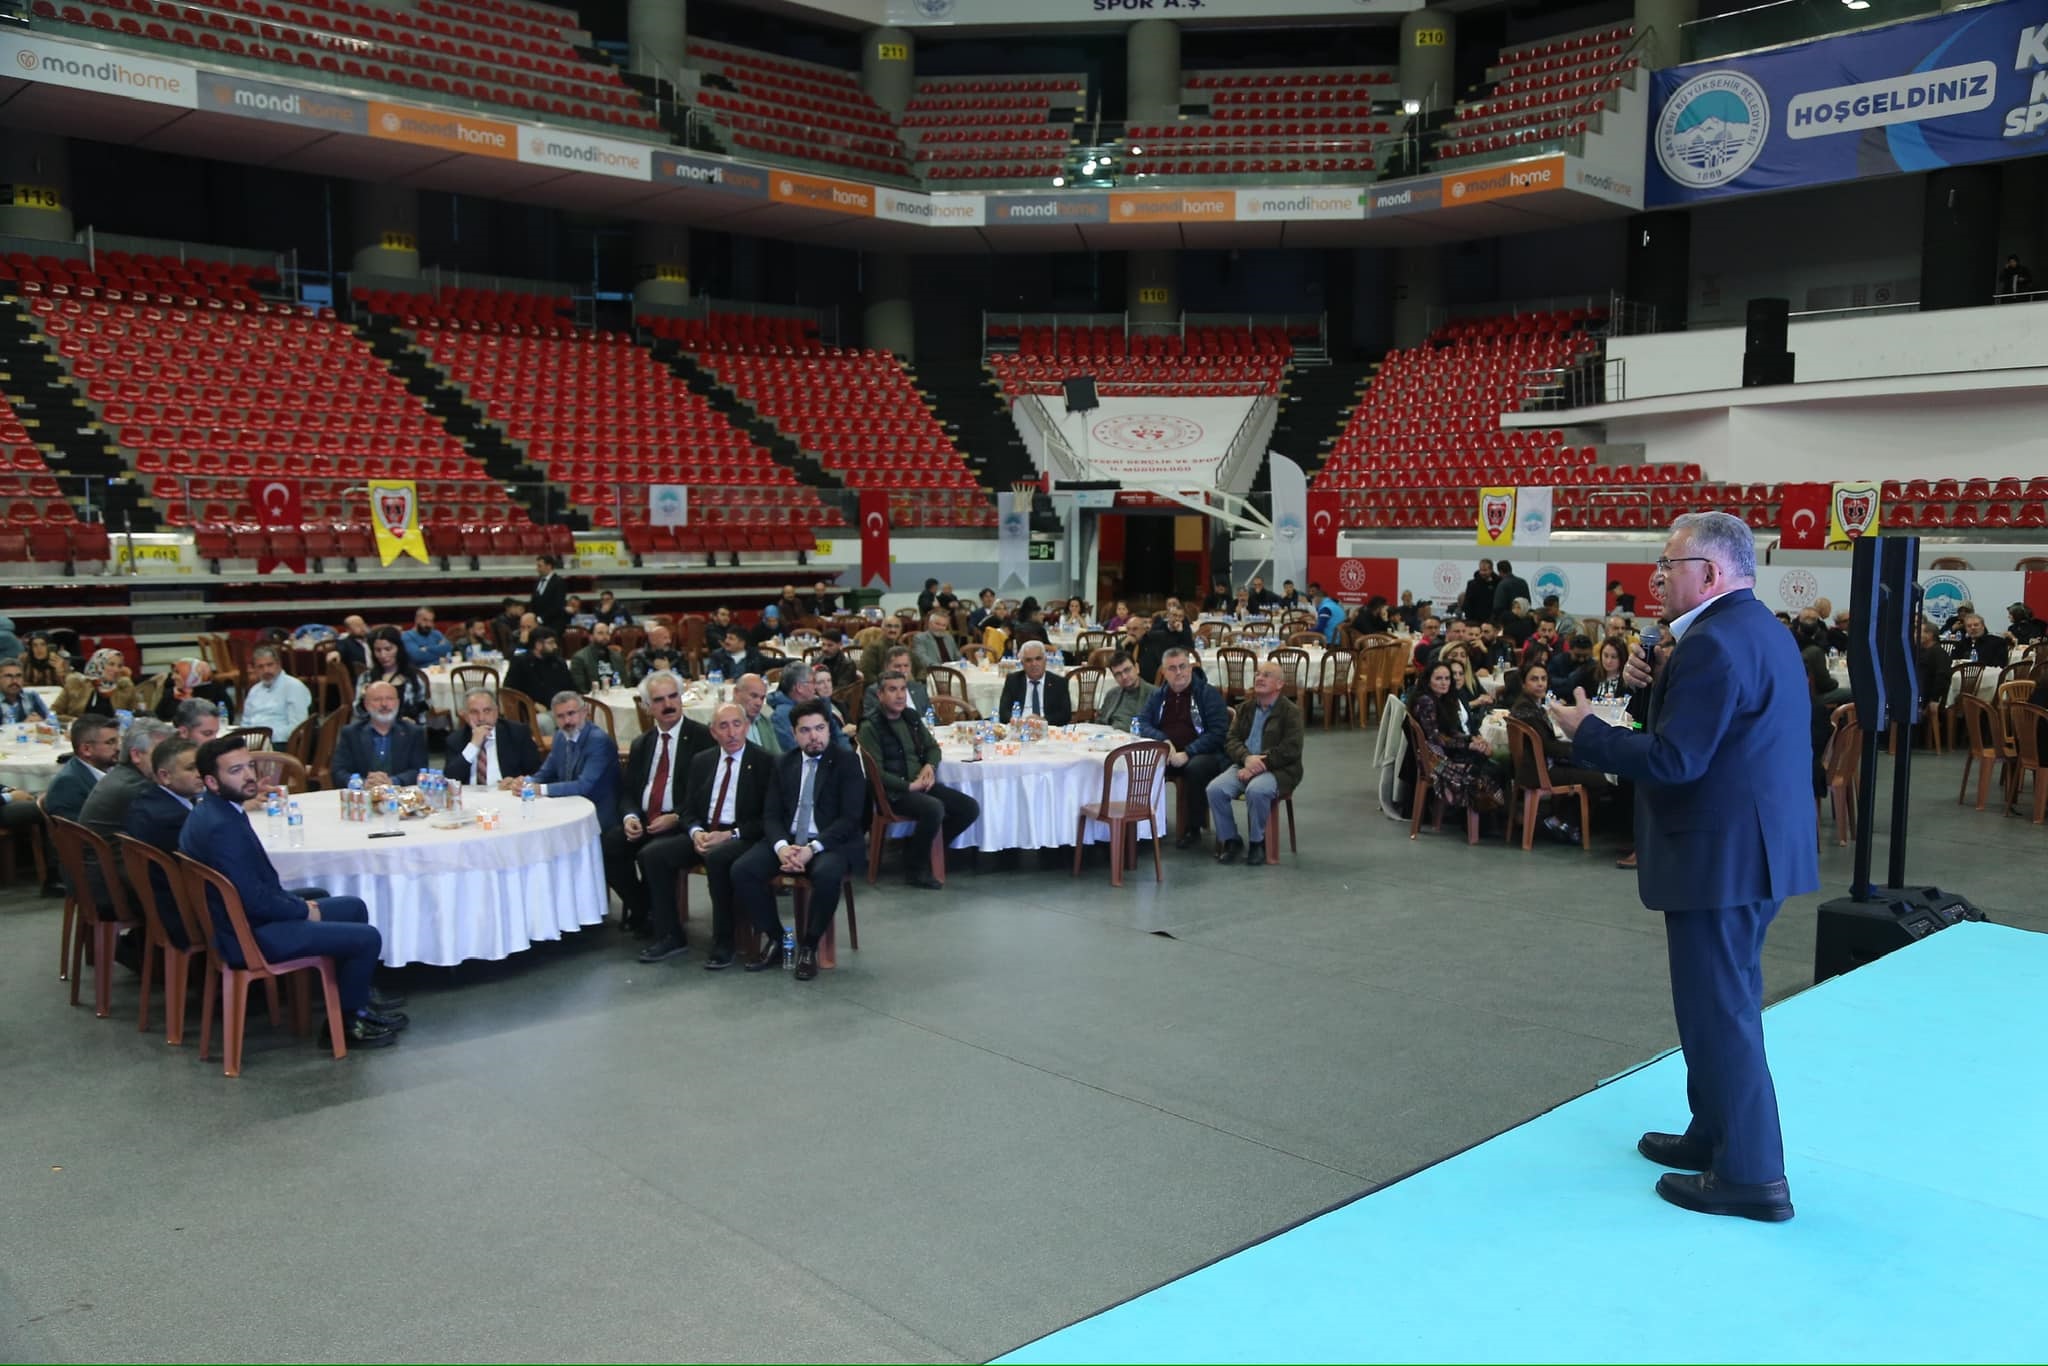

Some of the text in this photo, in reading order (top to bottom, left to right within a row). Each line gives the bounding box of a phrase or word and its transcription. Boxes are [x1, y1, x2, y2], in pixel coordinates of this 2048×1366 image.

[1418, 32, 1443, 44] 210
[882, 46, 905, 58] 211
[42, 54, 181, 93] mondihome
[234, 88, 353, 122] mondihome
[1794, 75, 1988, 126] HOŞGELDİNİZ
[400, 118, 506, 148] mondihome
[547, 140, 640, 170] mondihome
[1465, 167, 1551, 195] mondihome
[1585, 173, 1632, 199] mondihome
[896, 200, 974, 217] mondihome
[1010, 201, 1098, 217] mondihome
[1135, 199, 1224, 215] mondihome
[1262, 195, 1352, 212] mondihome
